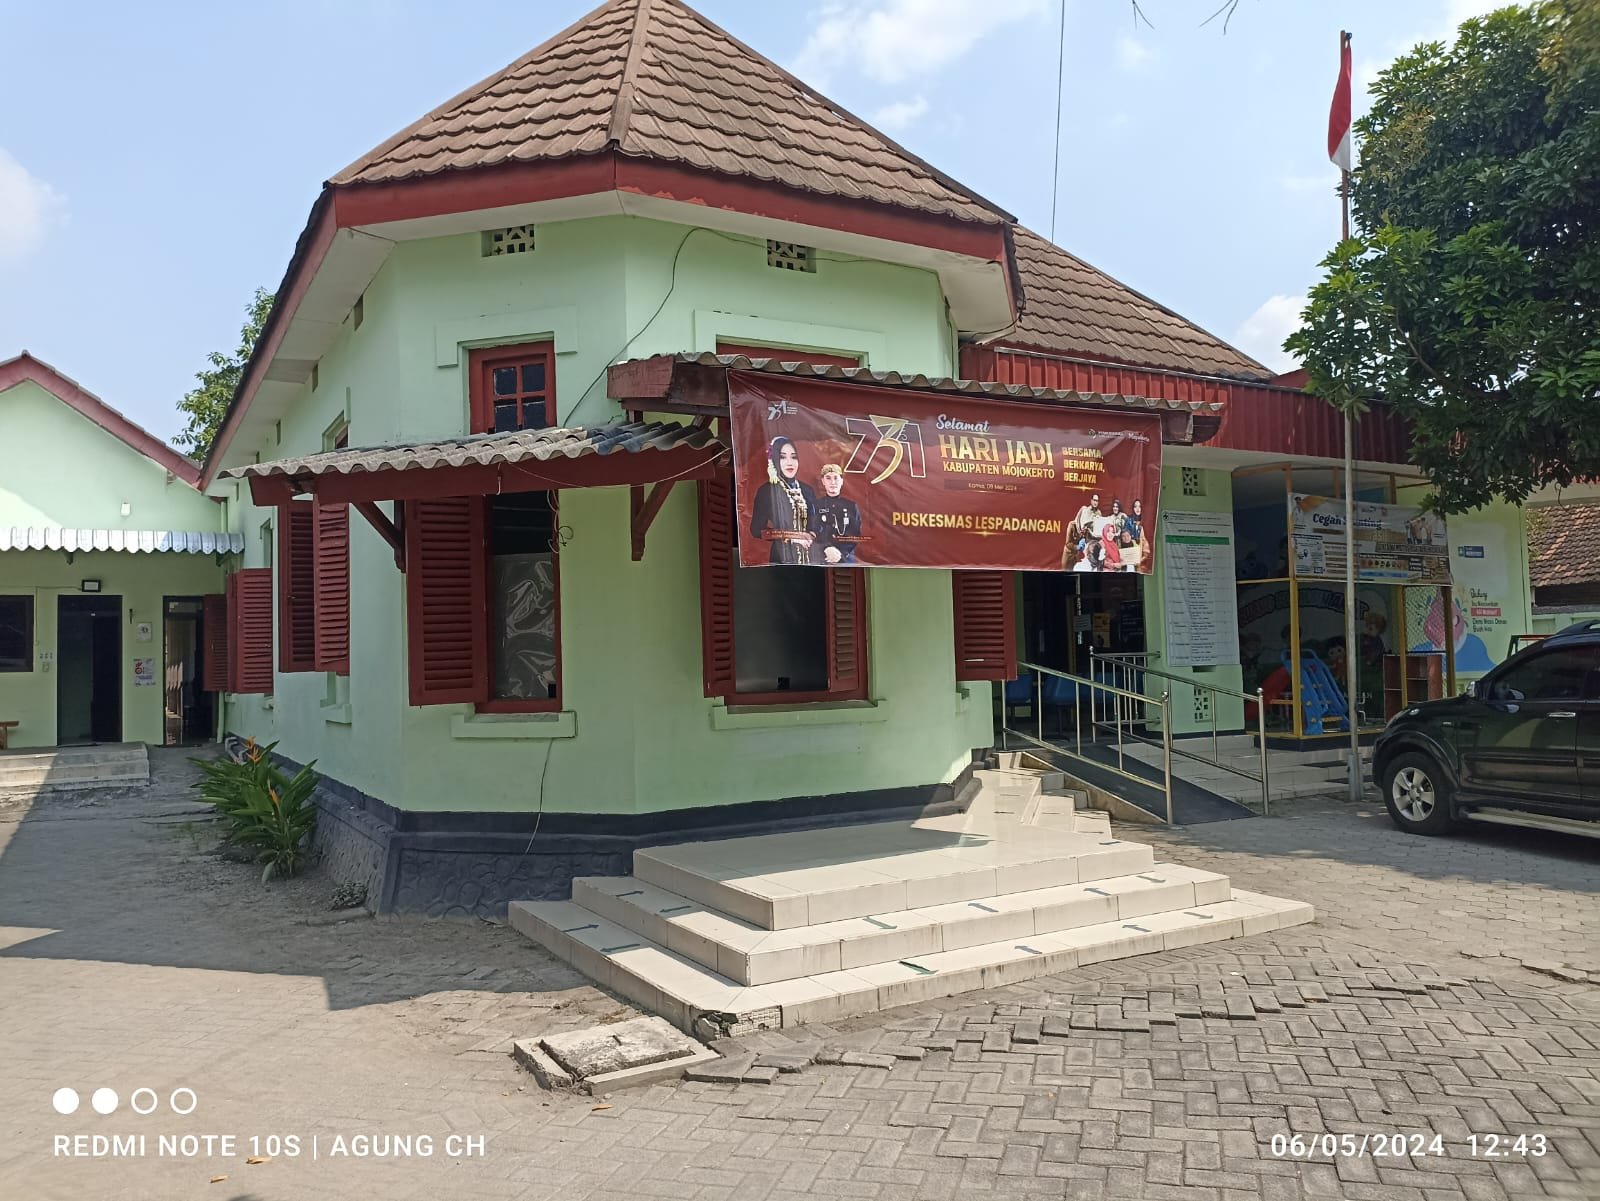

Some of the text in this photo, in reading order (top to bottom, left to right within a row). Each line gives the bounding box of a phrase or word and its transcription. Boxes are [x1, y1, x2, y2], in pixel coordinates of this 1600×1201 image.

[936, 413, 991, 433] Selamat
[938, 434, 1000, 462] HARI
[1005, 440, 1054, 466] JADI
[1062, 446, 1104, 460] BERSAMA,
[943, 461, 1055, 479] KABUPATEN MOJOKERTO
[1063, 459, 1105, 473] BERKARYA,
[1063, 472, 1097, 484] BERJAYA
[892, 511, 1061, 533] PUSKESMAS LESPADANGAN
[1344, 515, 1382, 530] nting
